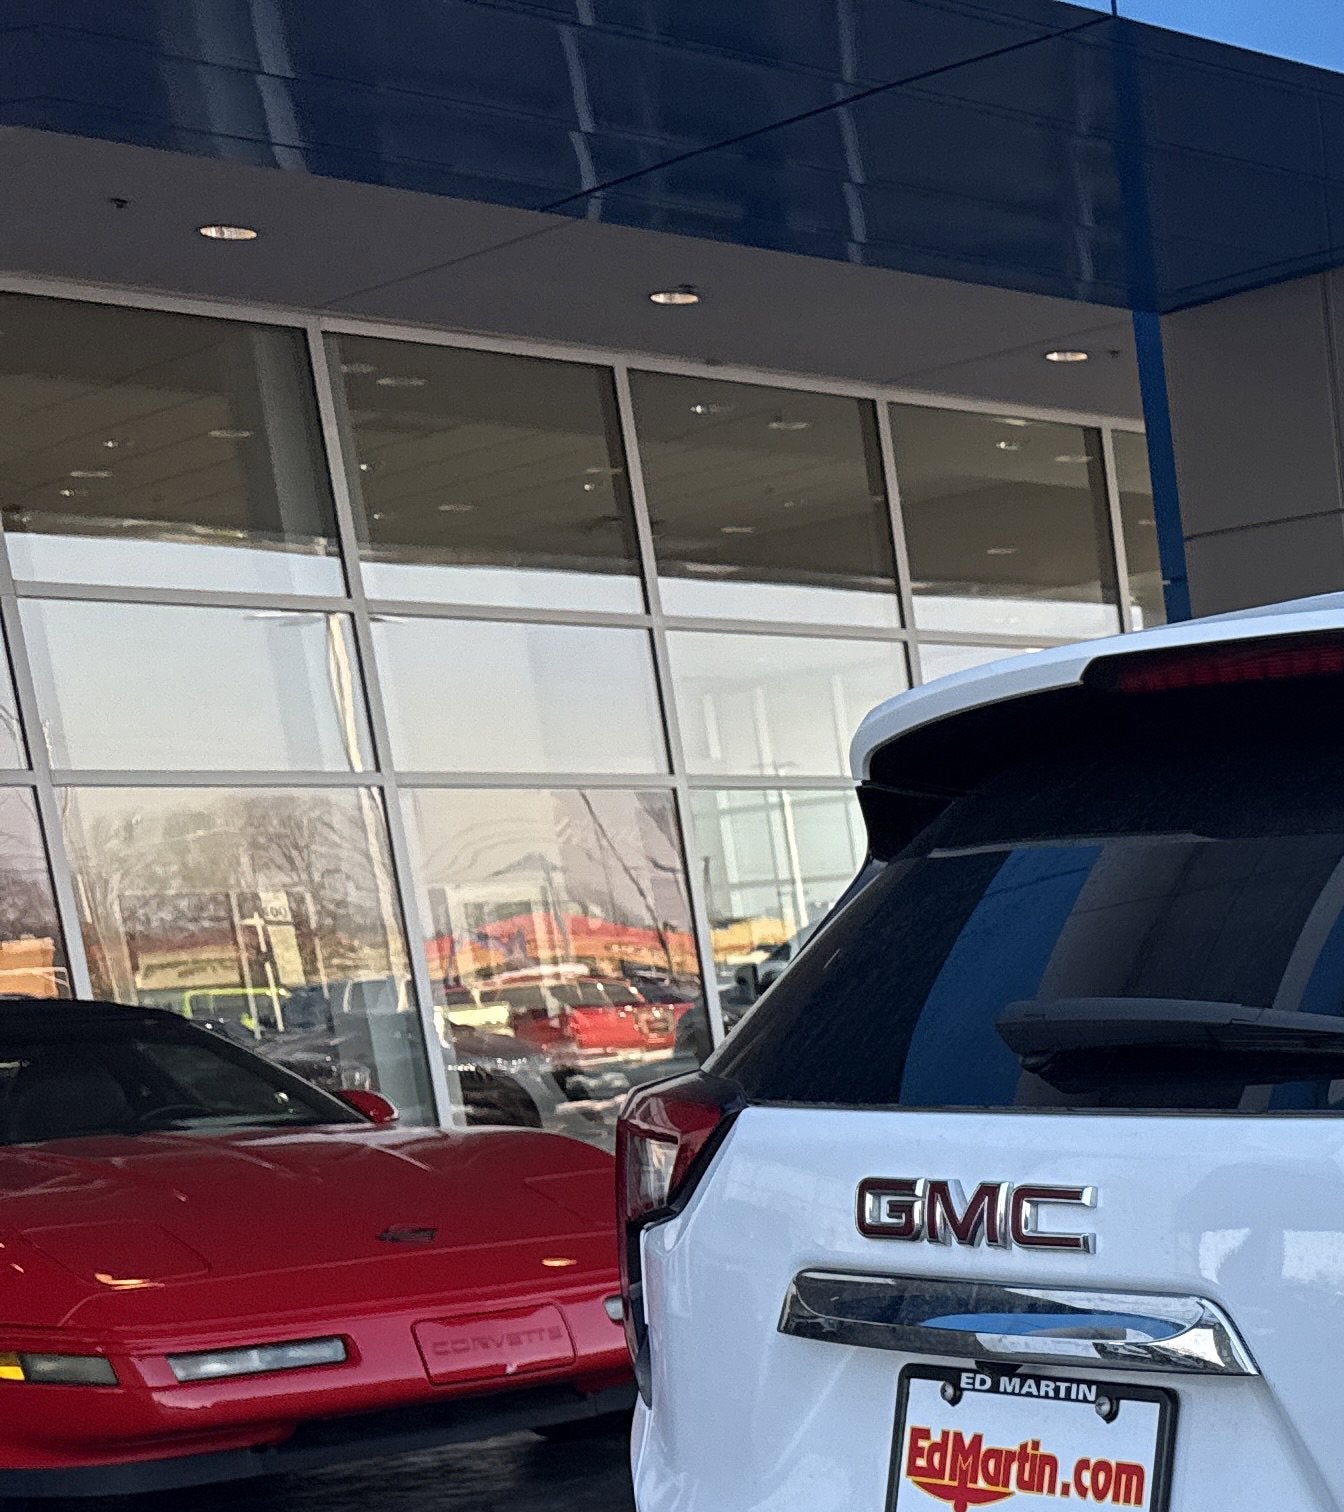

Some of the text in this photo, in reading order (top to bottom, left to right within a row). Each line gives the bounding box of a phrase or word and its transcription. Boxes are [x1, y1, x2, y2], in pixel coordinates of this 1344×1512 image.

[855, 1176, 1098, 1254] GMC
[432, 1315, 563, 1356] CORVETTE
[959, 1371, 1098, 1401] ED MARTIN
[905, 1425, 1146, 1508] EdMartin.com
